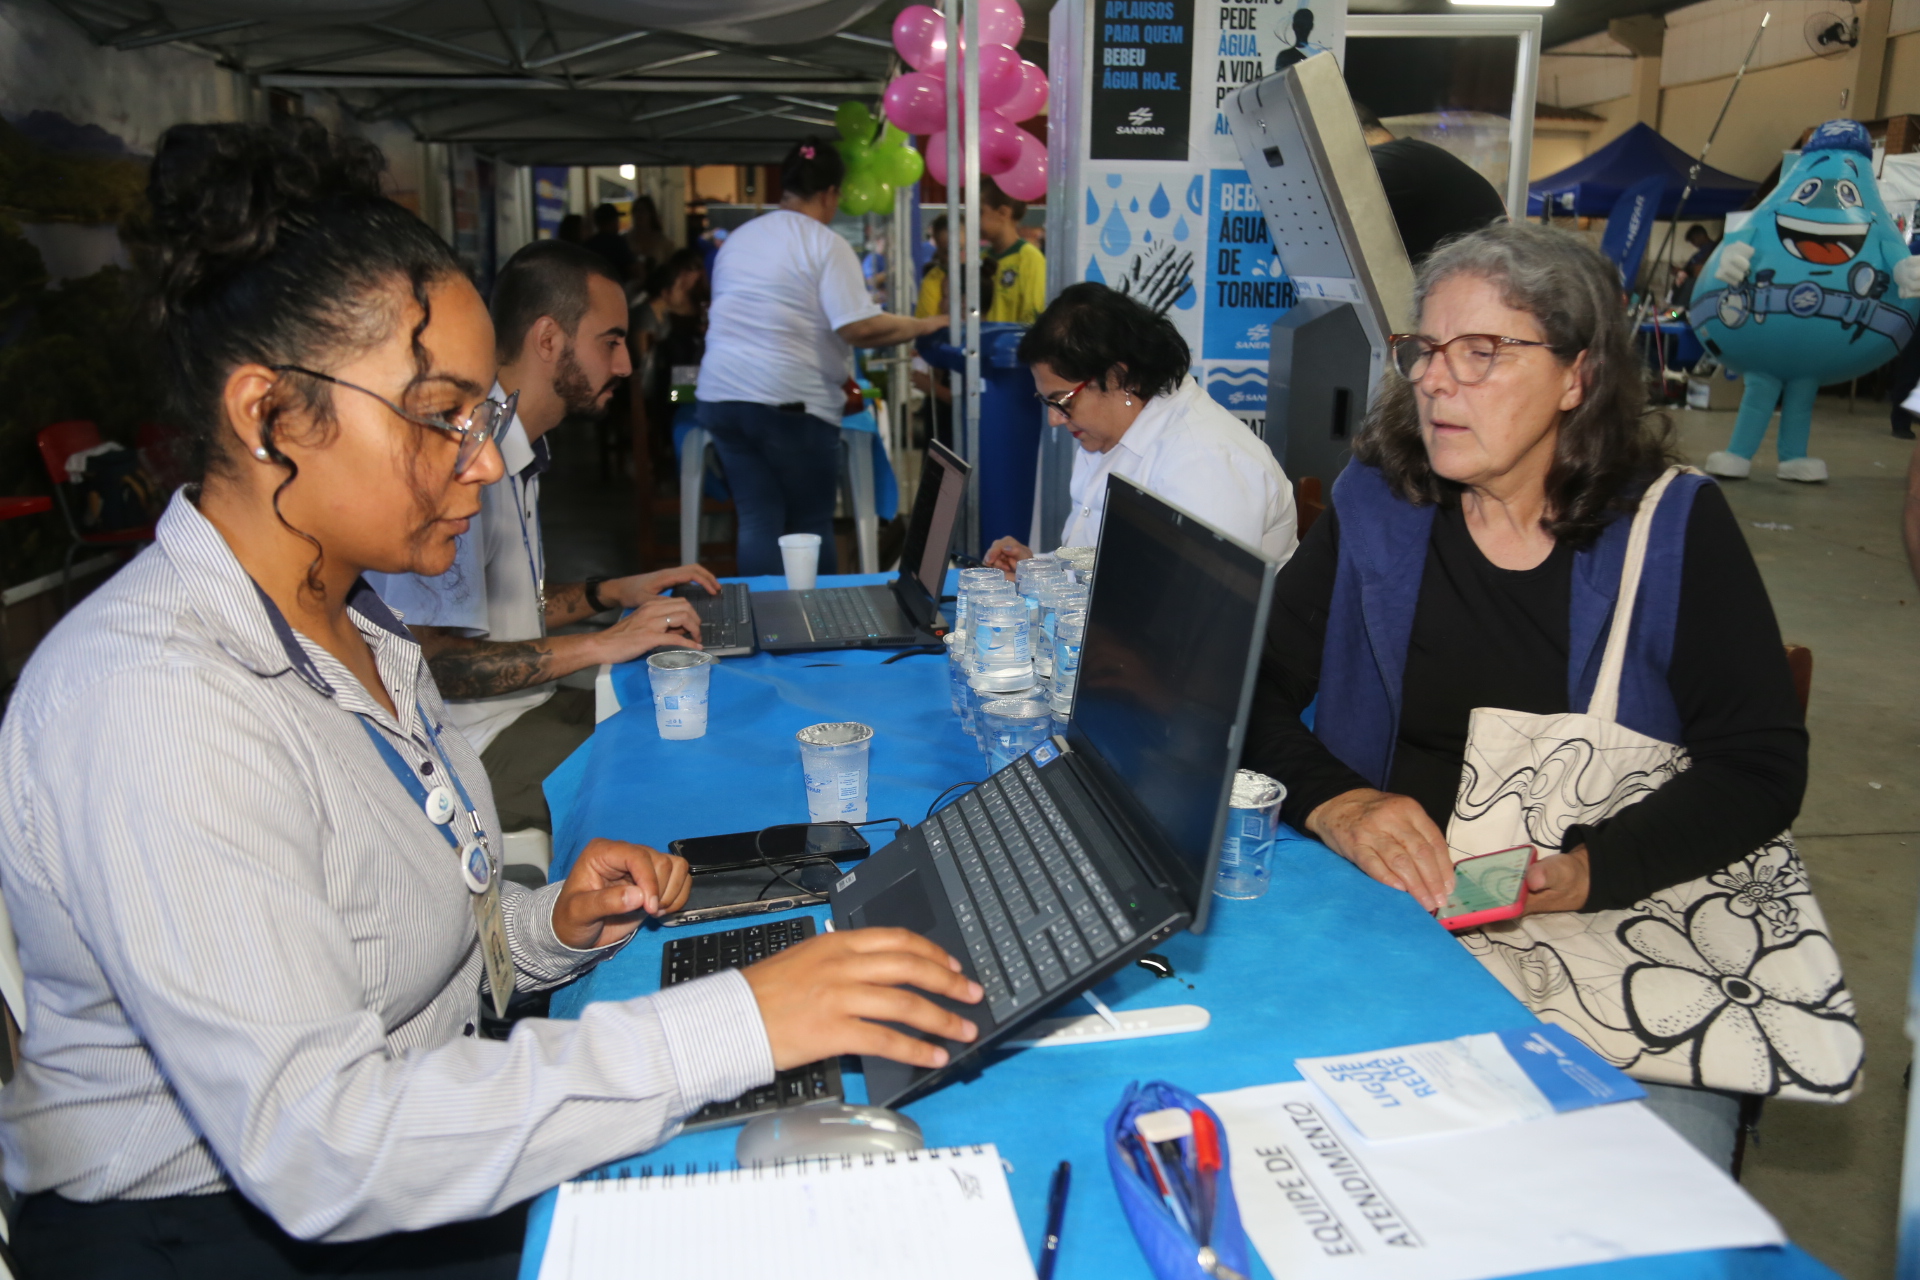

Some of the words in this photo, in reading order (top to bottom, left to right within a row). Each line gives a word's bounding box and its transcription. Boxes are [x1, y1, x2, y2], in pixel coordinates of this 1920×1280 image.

[1105, 1, 1174, 20] APLAUSOS
[1220, 7, 1257, 30] PEDE
[1104, 24, 1140, 42] PARA
[1144, 25, 1184, 44] QUEM
[1218, 30, 1261, 57] ÁGUA.
[1103, 48, 1146, 66] BEBEU
[1103, 68, 1139, 89] ÁGUA
[1142, 72, 1182, 90] HOJE.
[1217, 61, 1226, 82] A
[1230, 61, 1263, 83] VIDA
[1116, 126, 1165, 135] SANEPAR
[1221, 183, 1261, 211] BEB
[1219, 212, 1268, 243] ÁGUA
[1218, 248, 1242, 275] DE
[1217, 281, 1299, 308] TORNEIR
[1382, 1056, 1437, 1098] REDE
[1254, 1146, 1293, 1172] DE
[1282, 1102, 1418, 1248] ATENDIMENTO
[1276, 1178, 1354, 1256] EQUIPE
